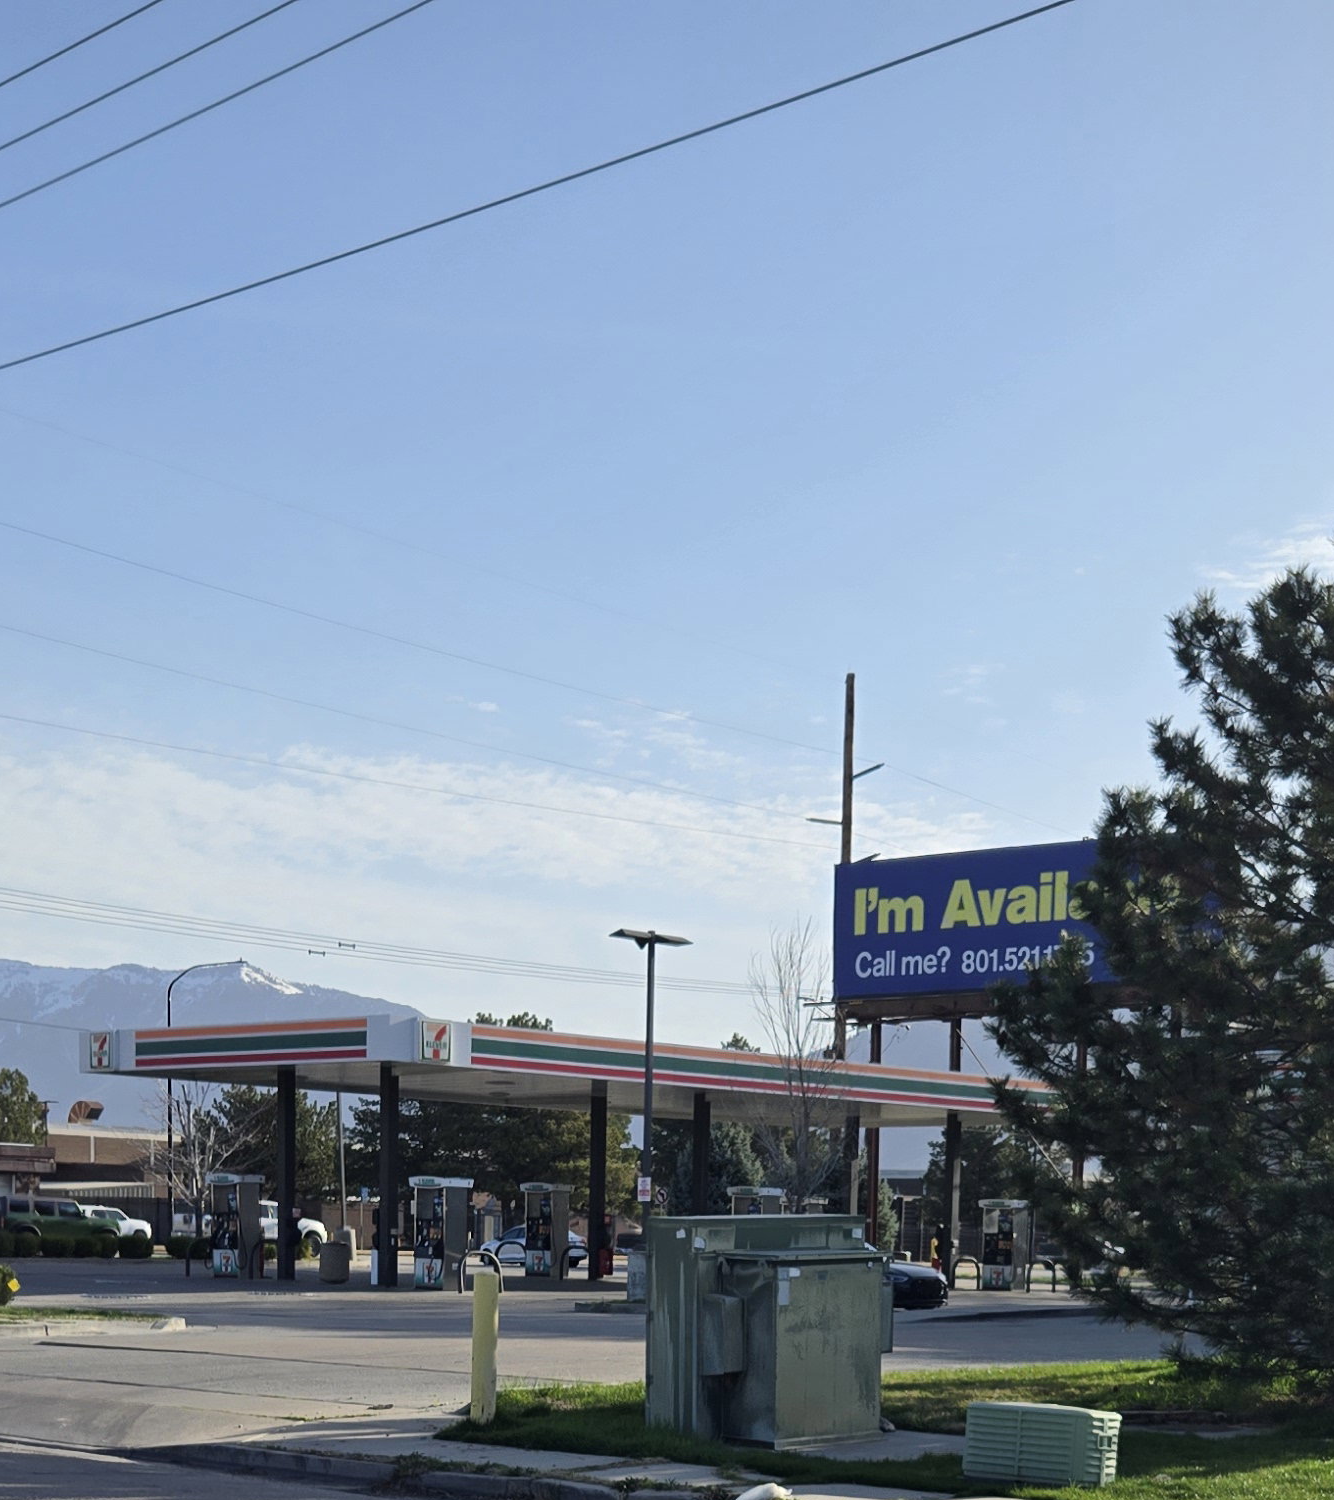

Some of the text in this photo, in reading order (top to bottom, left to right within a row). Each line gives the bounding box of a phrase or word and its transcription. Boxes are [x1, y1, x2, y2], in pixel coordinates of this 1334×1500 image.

[854, 887, 925, 936] I'm
[855, 942, 1095, 979] Call me? 801.52115
